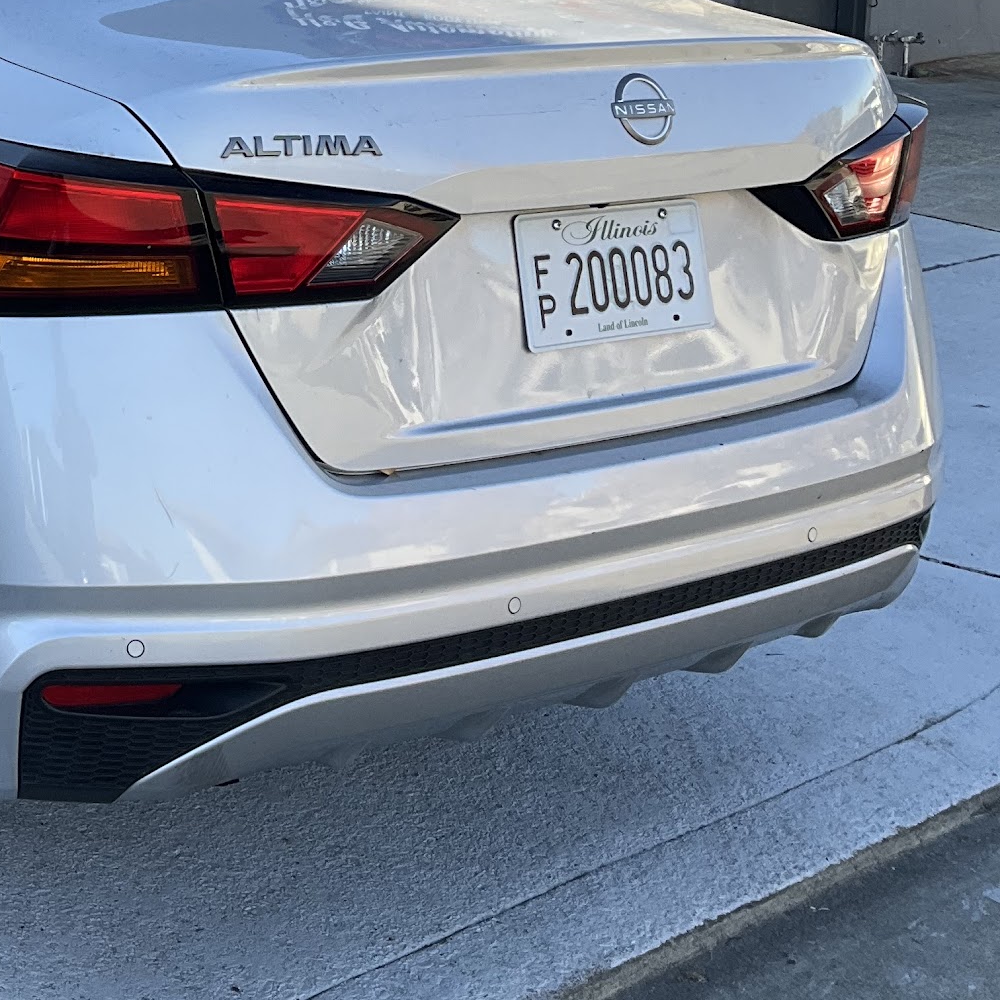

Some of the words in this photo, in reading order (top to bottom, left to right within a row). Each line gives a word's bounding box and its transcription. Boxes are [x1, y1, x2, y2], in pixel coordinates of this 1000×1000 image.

[615, 101, 675, 118] NISSAN
[220, 134, 383, 159] ALTIMA
[561, 215, 658, 246] Illinois
[565, 240, 695, 316] 200083
[598, 321, 615, 333] Land
[616, 319, 623, 331] of
[624, 317, 649, 329] Lincoln
